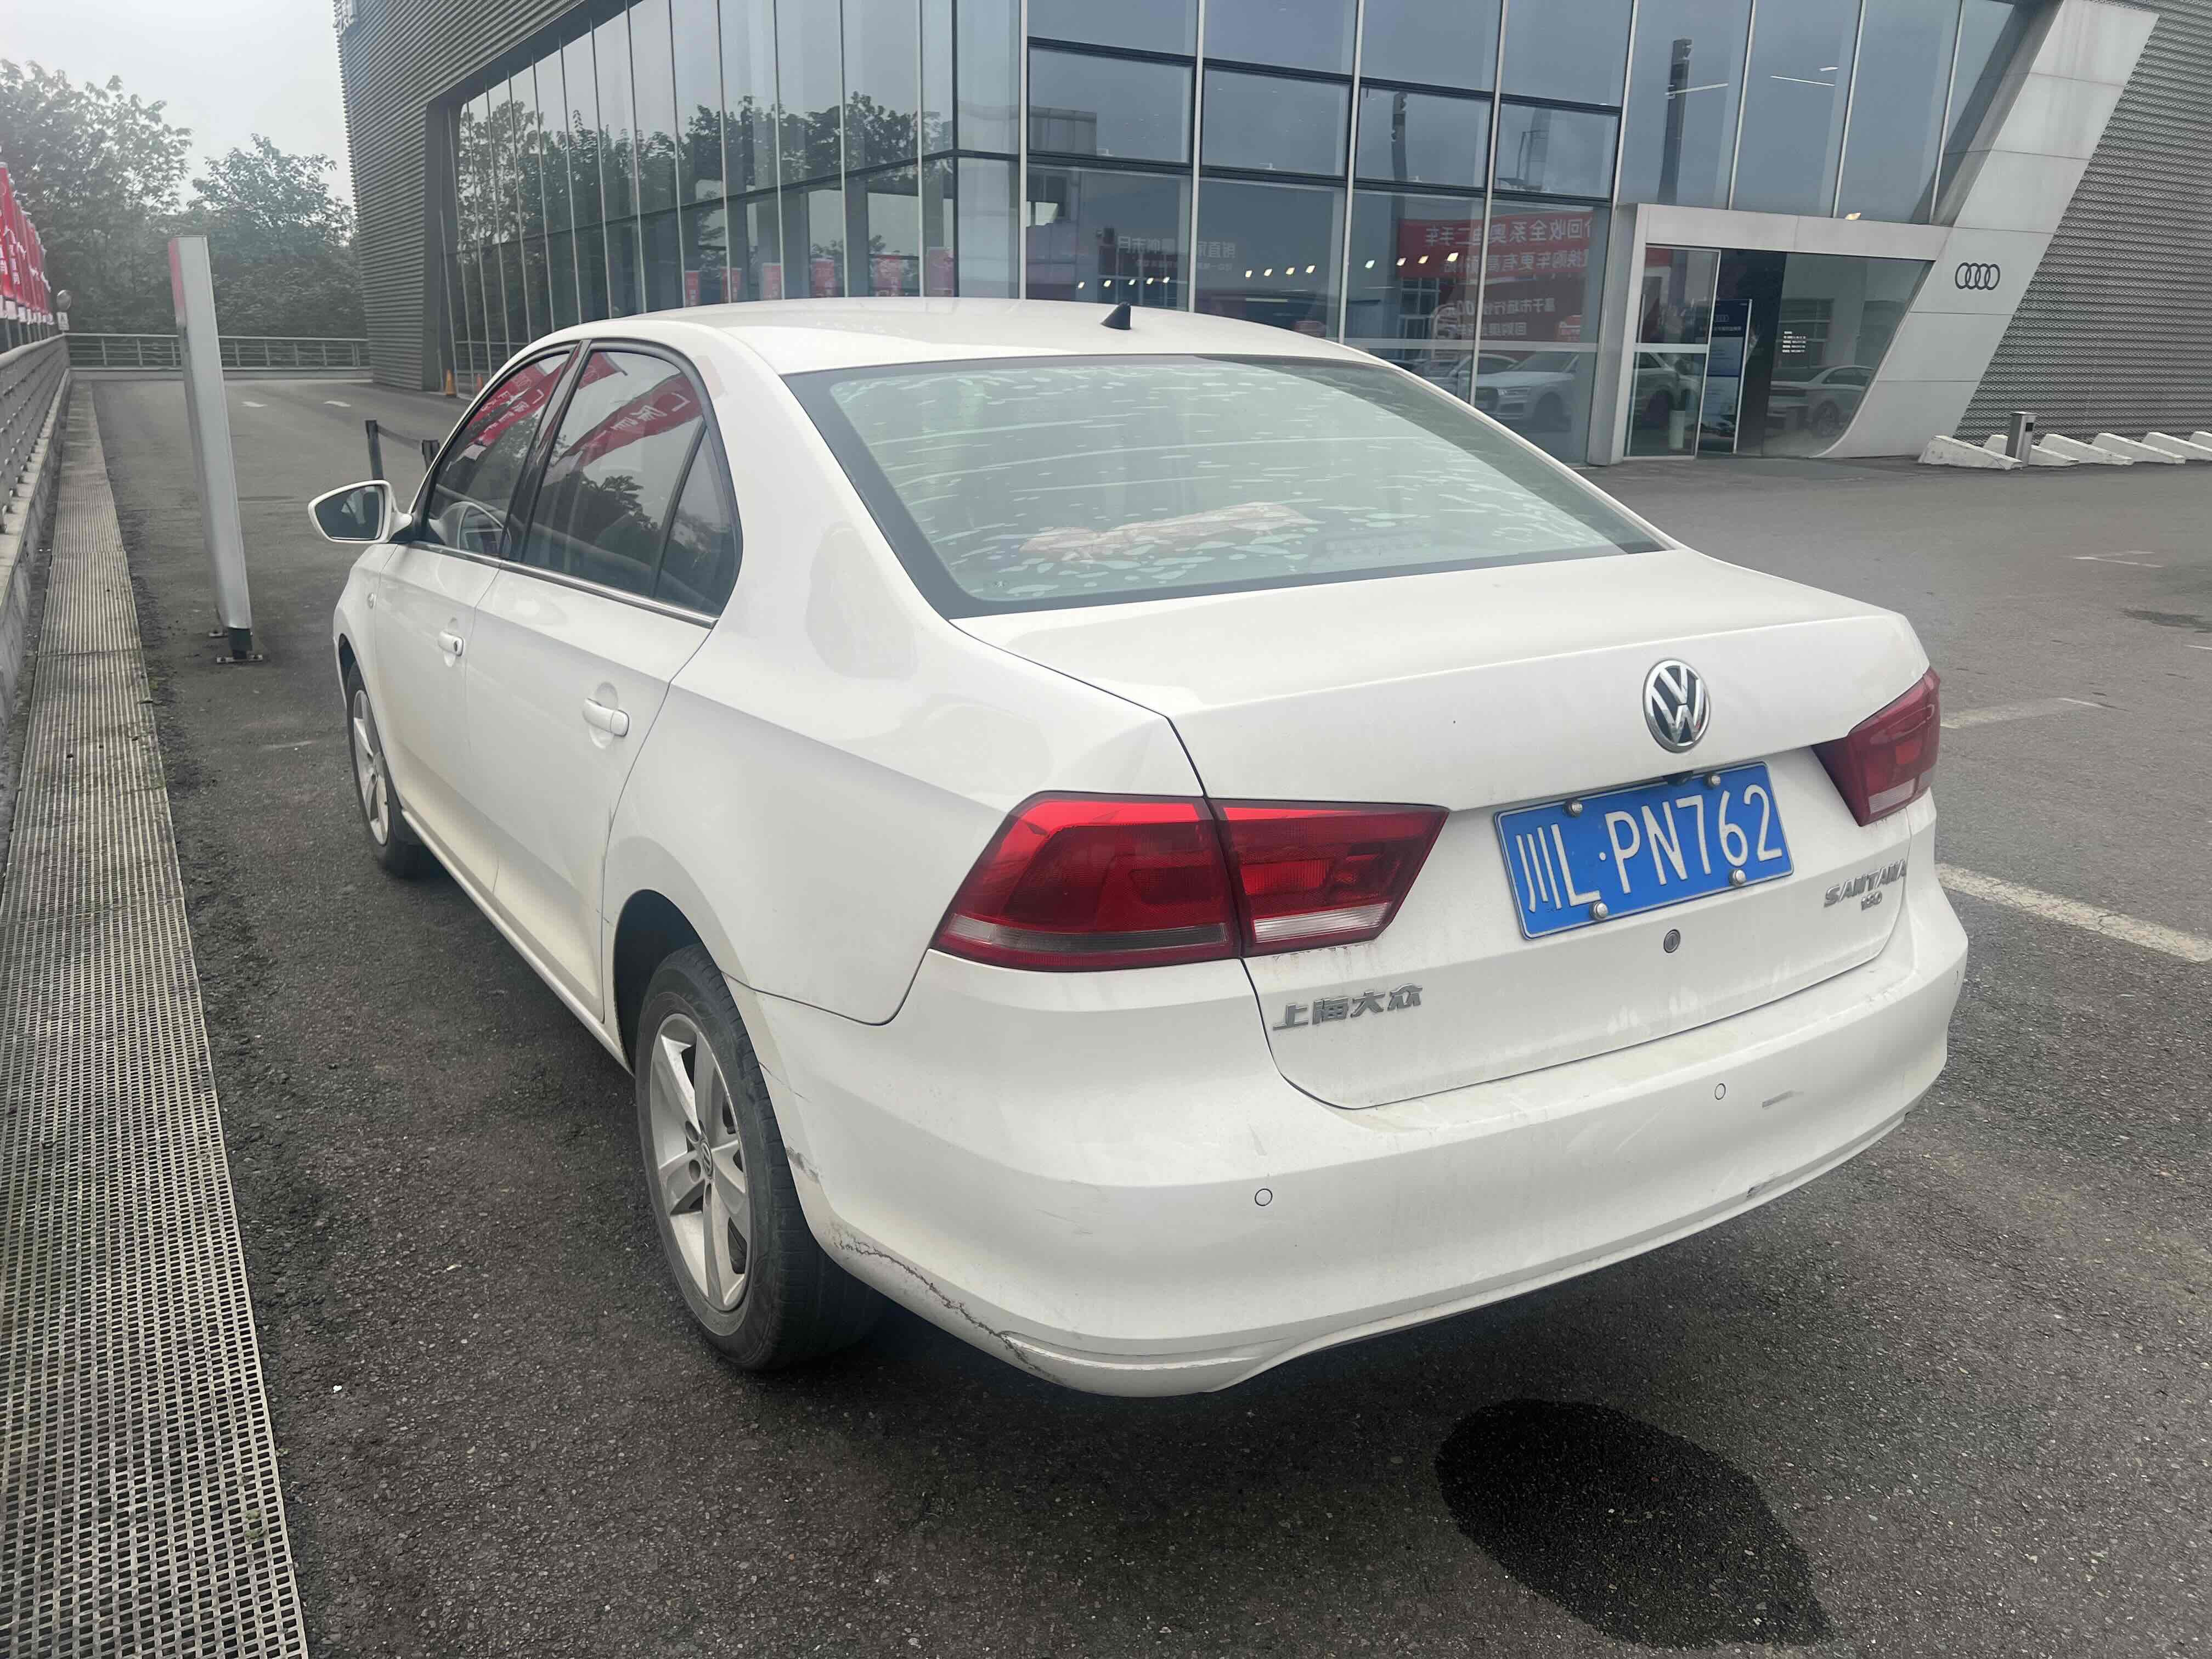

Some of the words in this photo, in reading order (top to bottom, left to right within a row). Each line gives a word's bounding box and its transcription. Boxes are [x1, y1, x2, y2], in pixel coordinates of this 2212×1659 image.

[1824, 859, 1906, 909] SANTANA
[1272, 983, 1423, 1031] 上海大众
